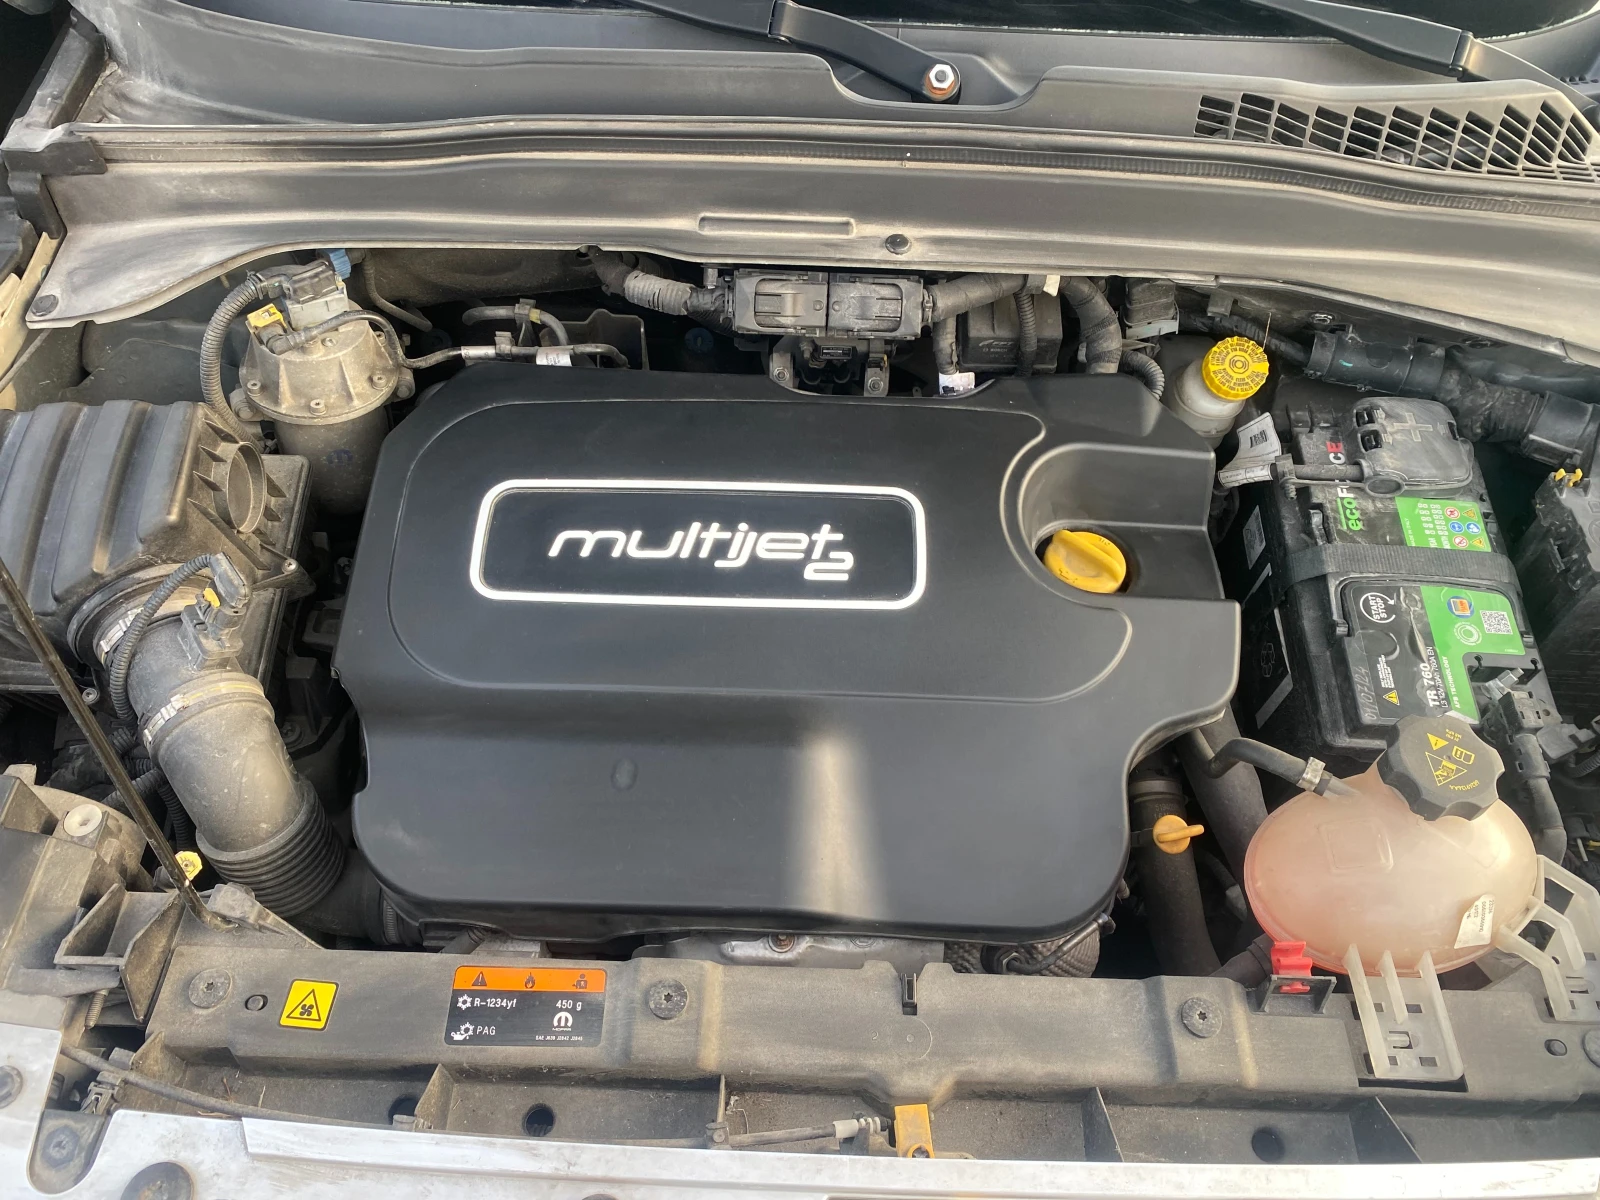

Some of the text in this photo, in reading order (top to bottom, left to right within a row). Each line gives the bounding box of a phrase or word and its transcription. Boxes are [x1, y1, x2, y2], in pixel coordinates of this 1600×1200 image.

[1368, 595, 1381, 620] START
[1376, 597, 1387, 618] STOP
[1426, 646, 1435, 656] EN
[1420, 663, 1440, 707] TR 760
[1442, 656, 1457, 695] TECHNOLOGY
[474, 997, 582, 1011] R-1234yf 450 g
[476, 1026, 496, 1035] PAG
